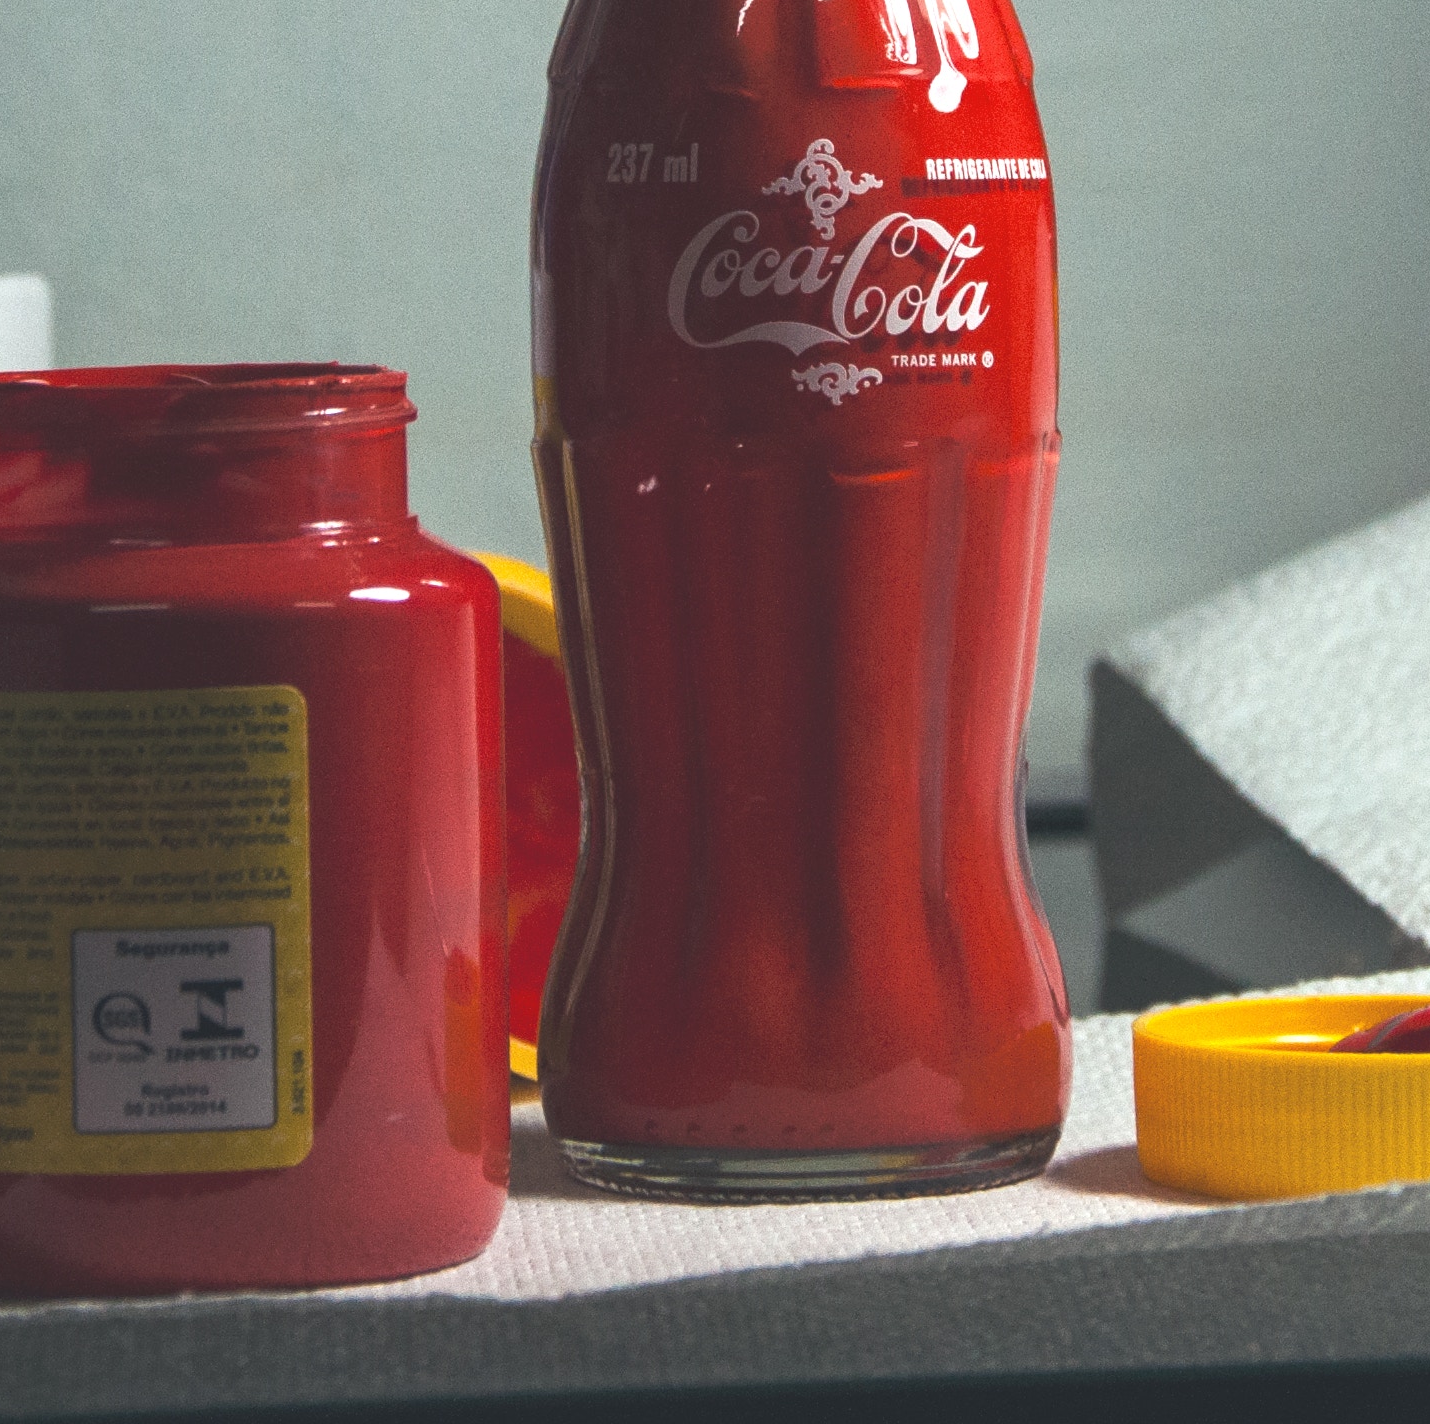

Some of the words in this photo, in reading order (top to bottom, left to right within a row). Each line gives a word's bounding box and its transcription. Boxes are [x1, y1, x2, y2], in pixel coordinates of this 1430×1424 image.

[607, 142, 654, 184] 237
[663, 142, 699, 183] ml
[925, 158, 1018, 180] REFRIGERANTE
[668, 210, 991, 356] Coca-Cola
[891, 354, 937, 367] TRADE
[941, 352, 977, 366] MARK
[116, 940, 229, 960] Segurança
[165, 1044, 260, 1064] INMETRO
